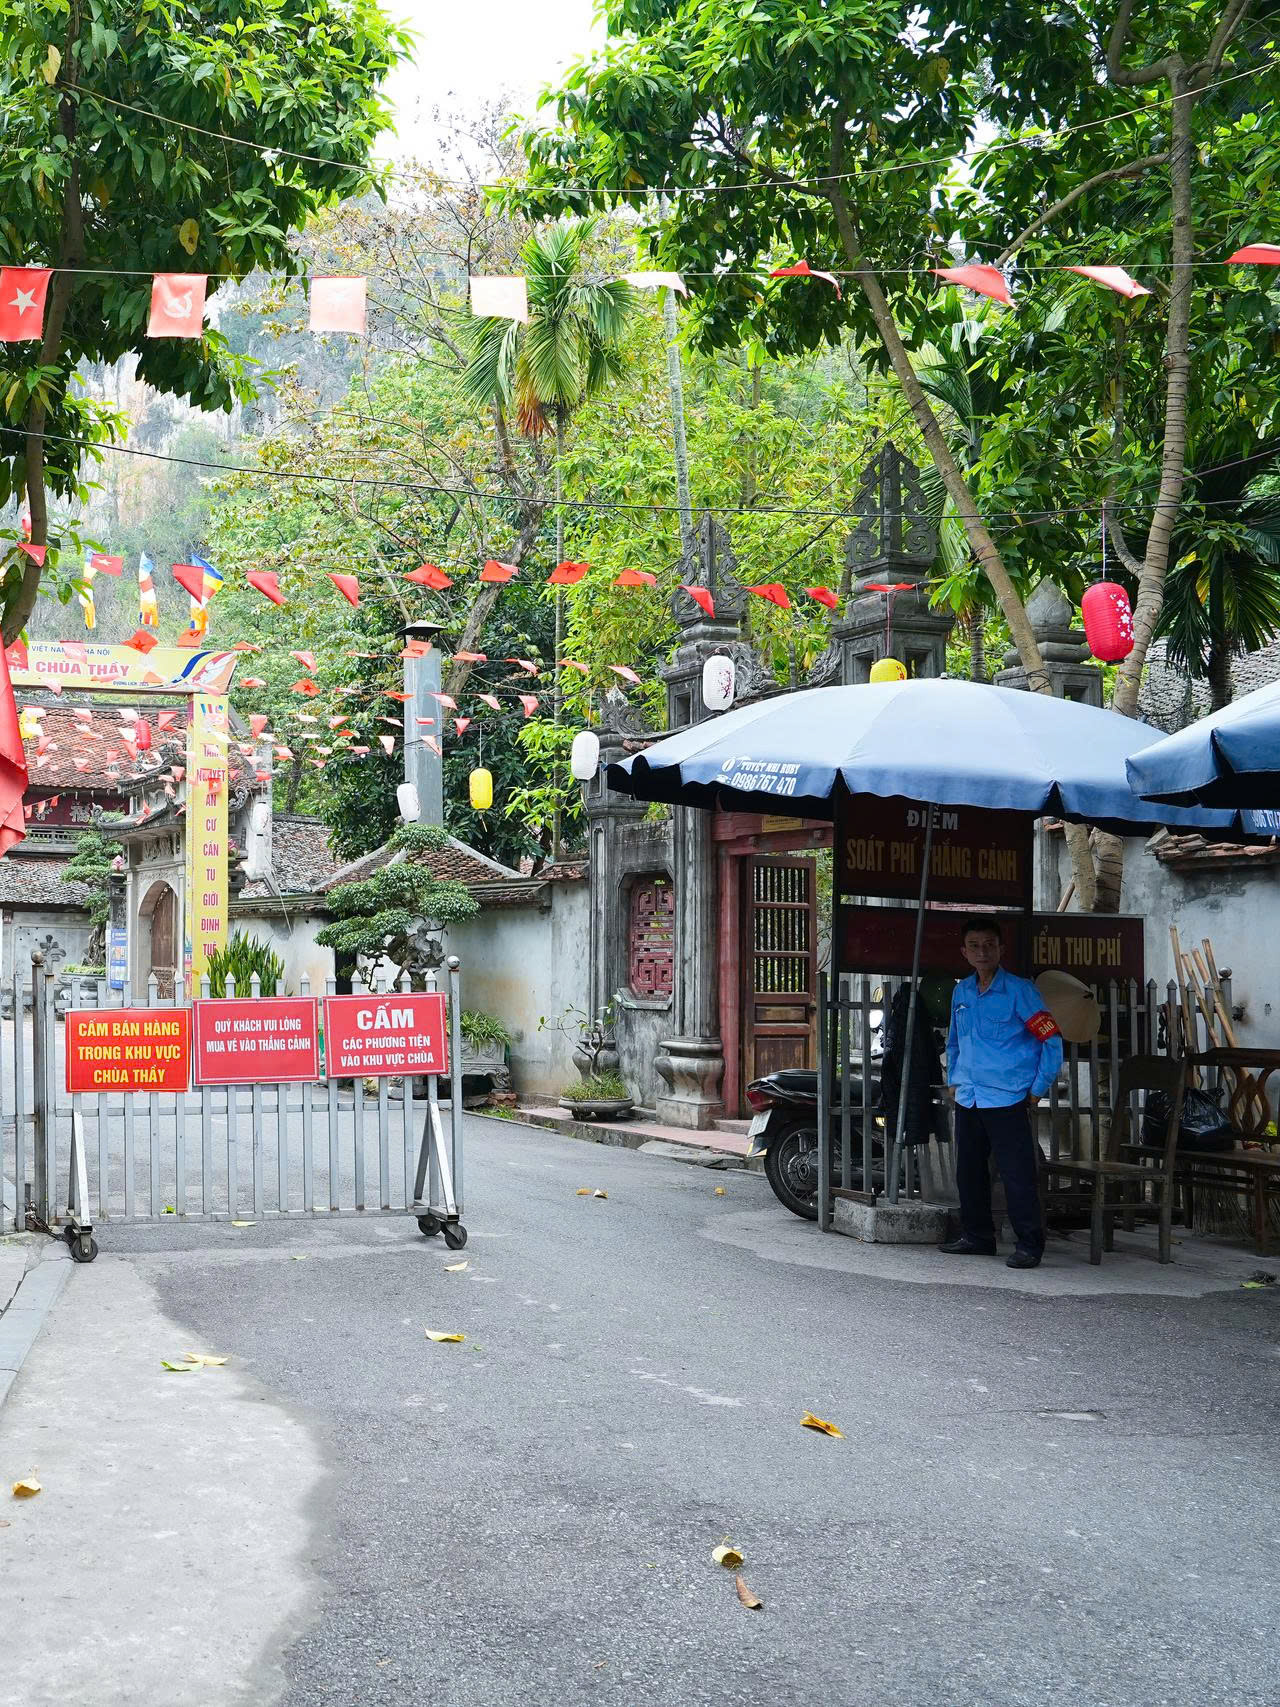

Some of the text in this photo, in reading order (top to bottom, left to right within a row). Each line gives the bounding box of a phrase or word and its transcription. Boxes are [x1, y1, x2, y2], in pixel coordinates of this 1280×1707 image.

[36, 659, 81, 676] CHÙA
[88, 661, 130, 677] THẦY
[206, 794, 217, 806] AN
[206, 818, 217, 831] CƯ
[907, 805, 958, 830] ĐIỂM
[847, 834, 1017, 881] SOÁT PHÍ HẮNG CẢNH
[206, 868, 216, 881] TU
[203, 891, 218, 906] GIỚI
[201, 918, 220, 933] ĐỊNH
[1034, 925, 1122, 966] IỂM THU PHÍ
[234, 1018, 261, 1032] KHÁCH
[264, 1019, 278, 1031] VUI
[280, 1016, 302, 1031] LÒNG
[357, 1002, 415, 1030] CẤM
[78, 1018, 180, 1036] CẤM BÁN HÀNG
[206, 1040, 225, 1053] MUA
[240, 1037, 256, 1051] VÀO
[258, 1035, 285, 1051] THẮNG
[288, 1035, 311, 1050] CẢNH
[342, 1034, 431, 1050] CÁC PHƯƠNG TIỆN
[78, 1044, 181, 1062] TRONG KHU VỰC
[341, 1051, 434, 1067] VÀO KHU VỰC CHÙA
[93, 1065, 166, 1083] CHÙA THẦY
